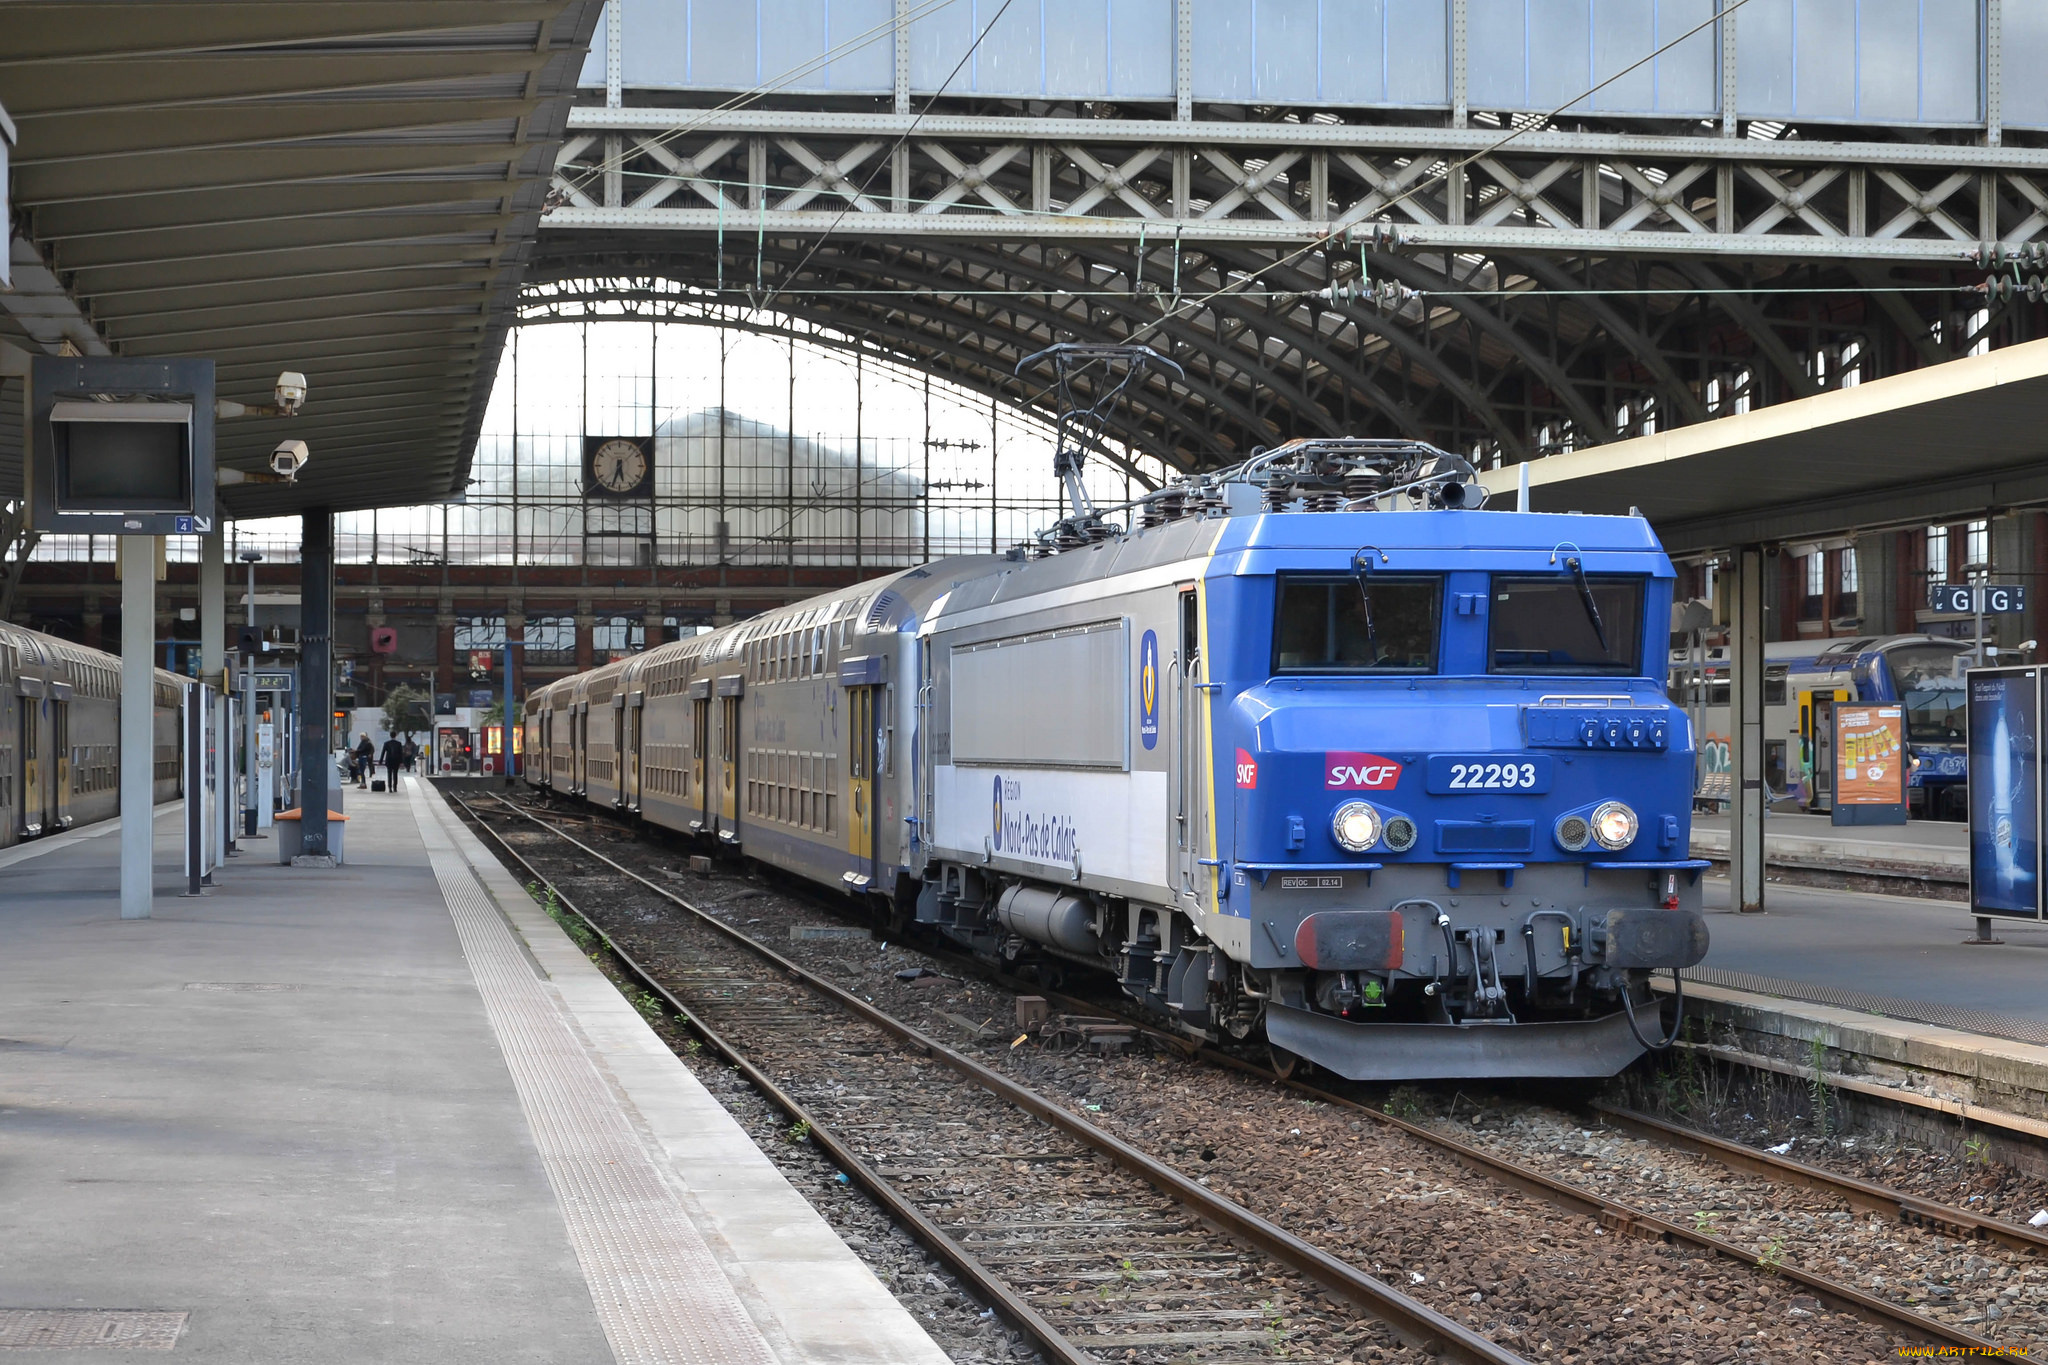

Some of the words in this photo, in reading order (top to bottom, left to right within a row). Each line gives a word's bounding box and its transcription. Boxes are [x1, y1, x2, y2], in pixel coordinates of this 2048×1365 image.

[180, 522, 187, 531] 4
[1952, 590, 1968, 610] G
[1991, 590, 2008, 610] G
[443, 700, 449, 709] 4
[1236, 763, 1255, 784] SNCF
[1327, 765, 1398, 785] SNCF
[1449, 764, 1536, 788] 22293
[1040, 813, 1049, 859] de
[1051, 815, 1076, 862] Calais
